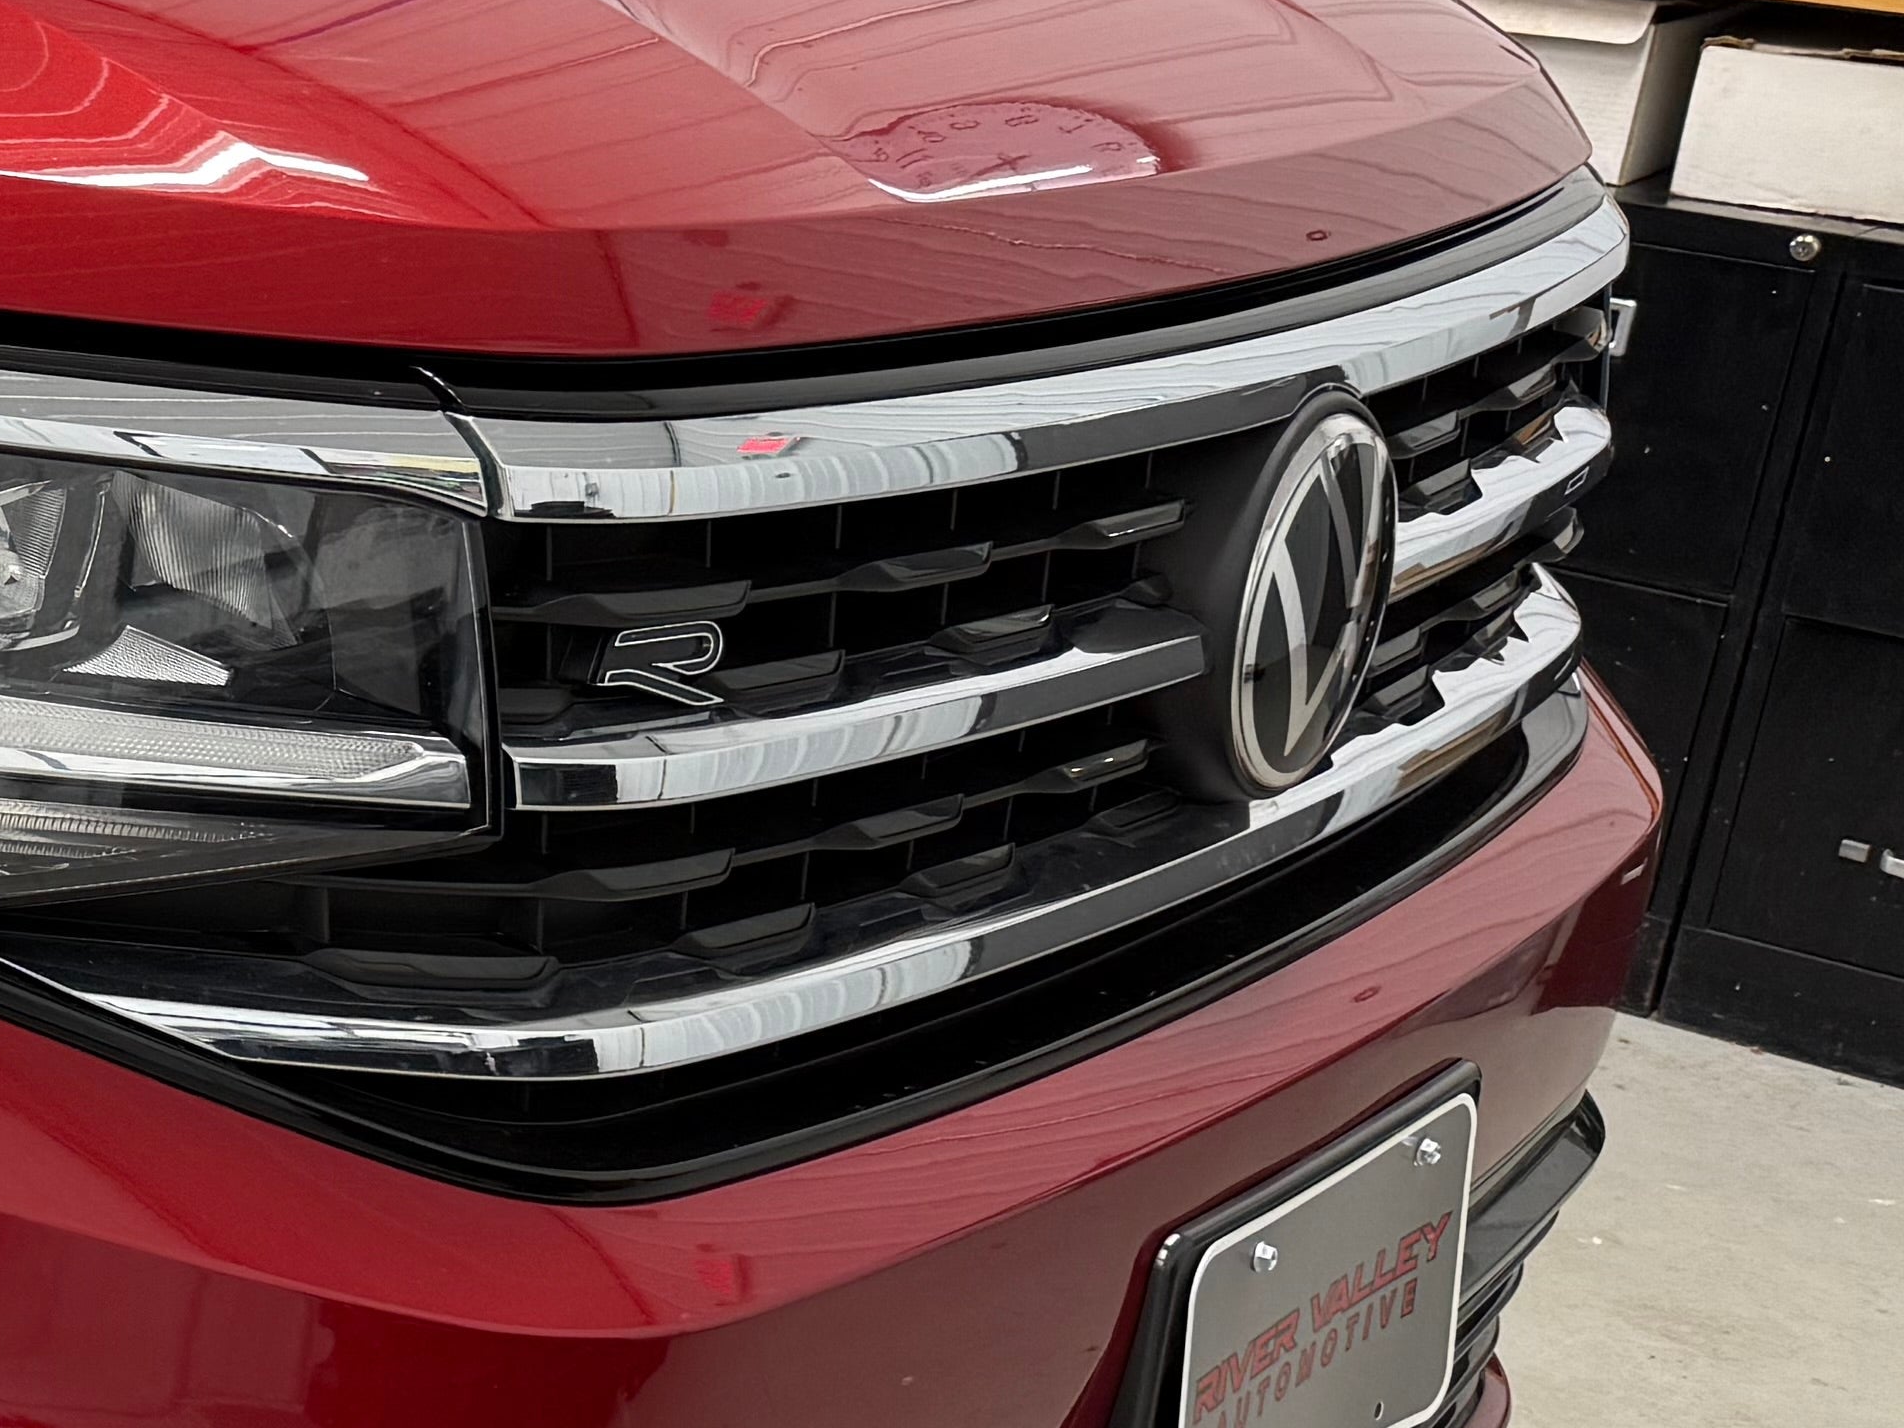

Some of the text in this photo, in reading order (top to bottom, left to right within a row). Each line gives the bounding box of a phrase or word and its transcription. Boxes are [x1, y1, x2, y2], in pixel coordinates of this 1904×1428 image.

[597, 621, 725, 706] R
[1193, 1211, 1453, 1425] RIVER VALLEY
